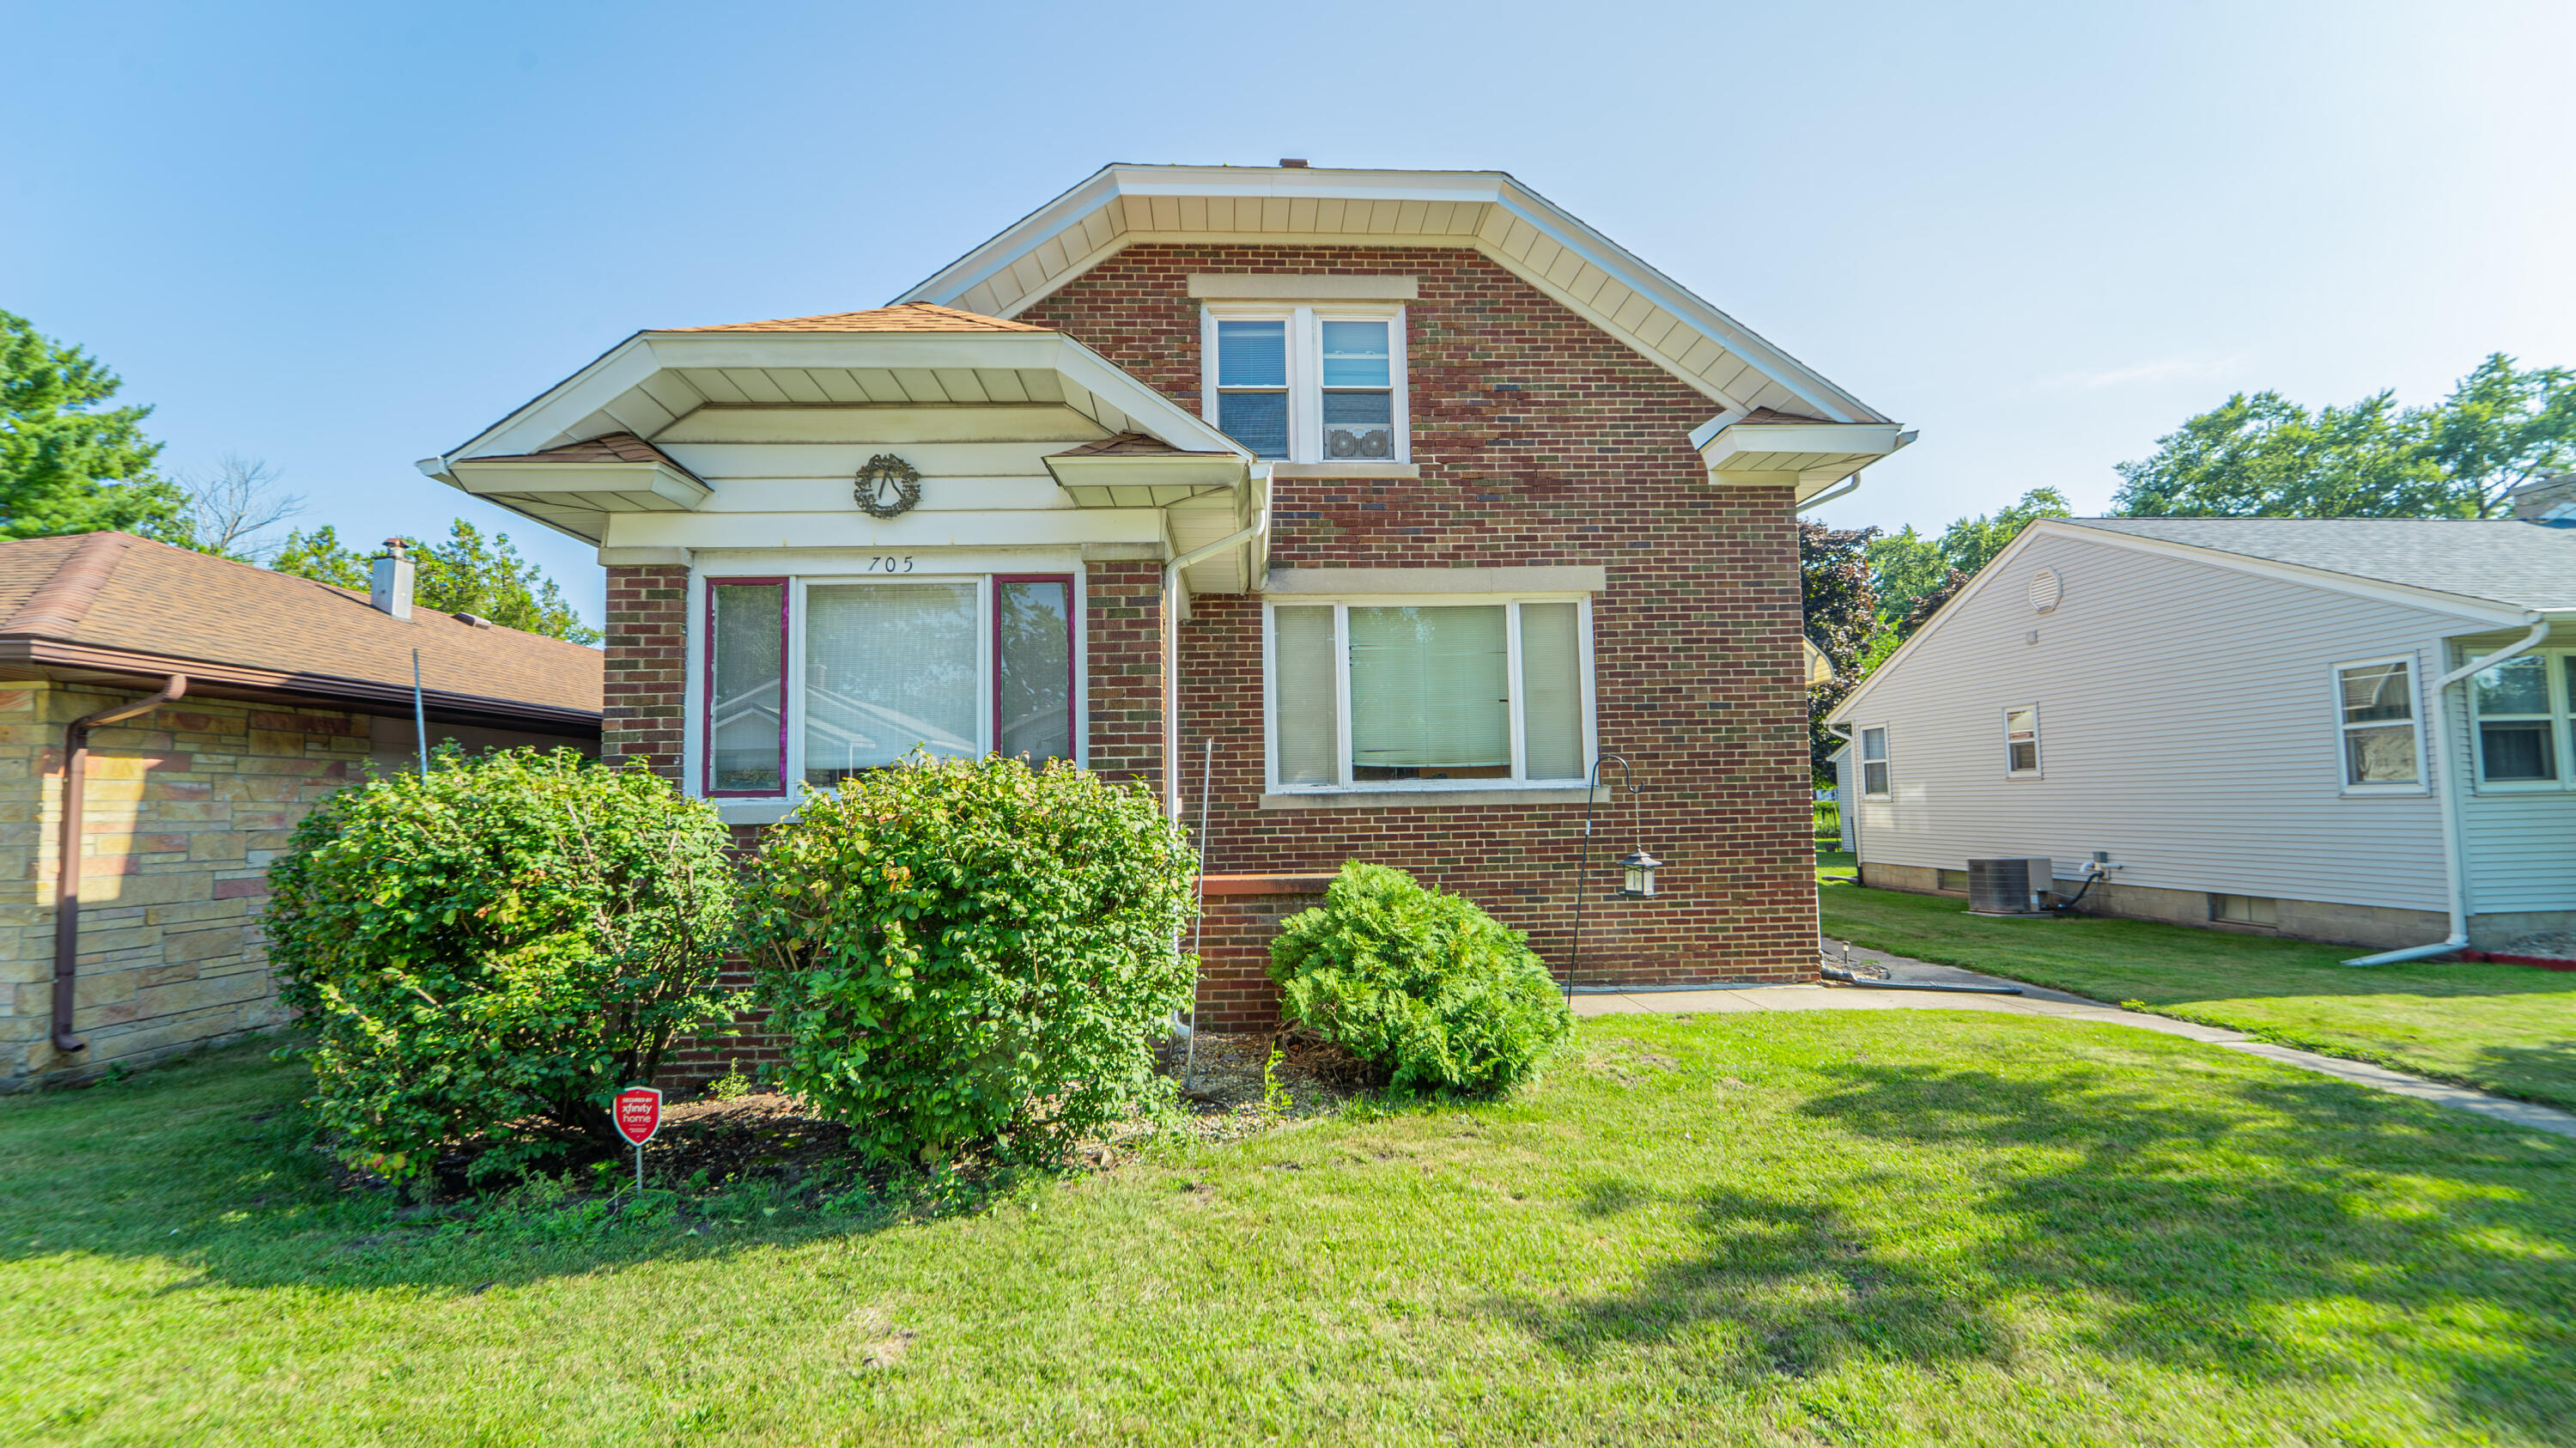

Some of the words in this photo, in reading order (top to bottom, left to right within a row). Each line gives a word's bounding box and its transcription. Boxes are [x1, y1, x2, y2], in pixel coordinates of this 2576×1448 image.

[868, 557, 913, 573] 705
[622, 1103, 653, 1114] xfinity
[623, 1114, 651, 1123] home
